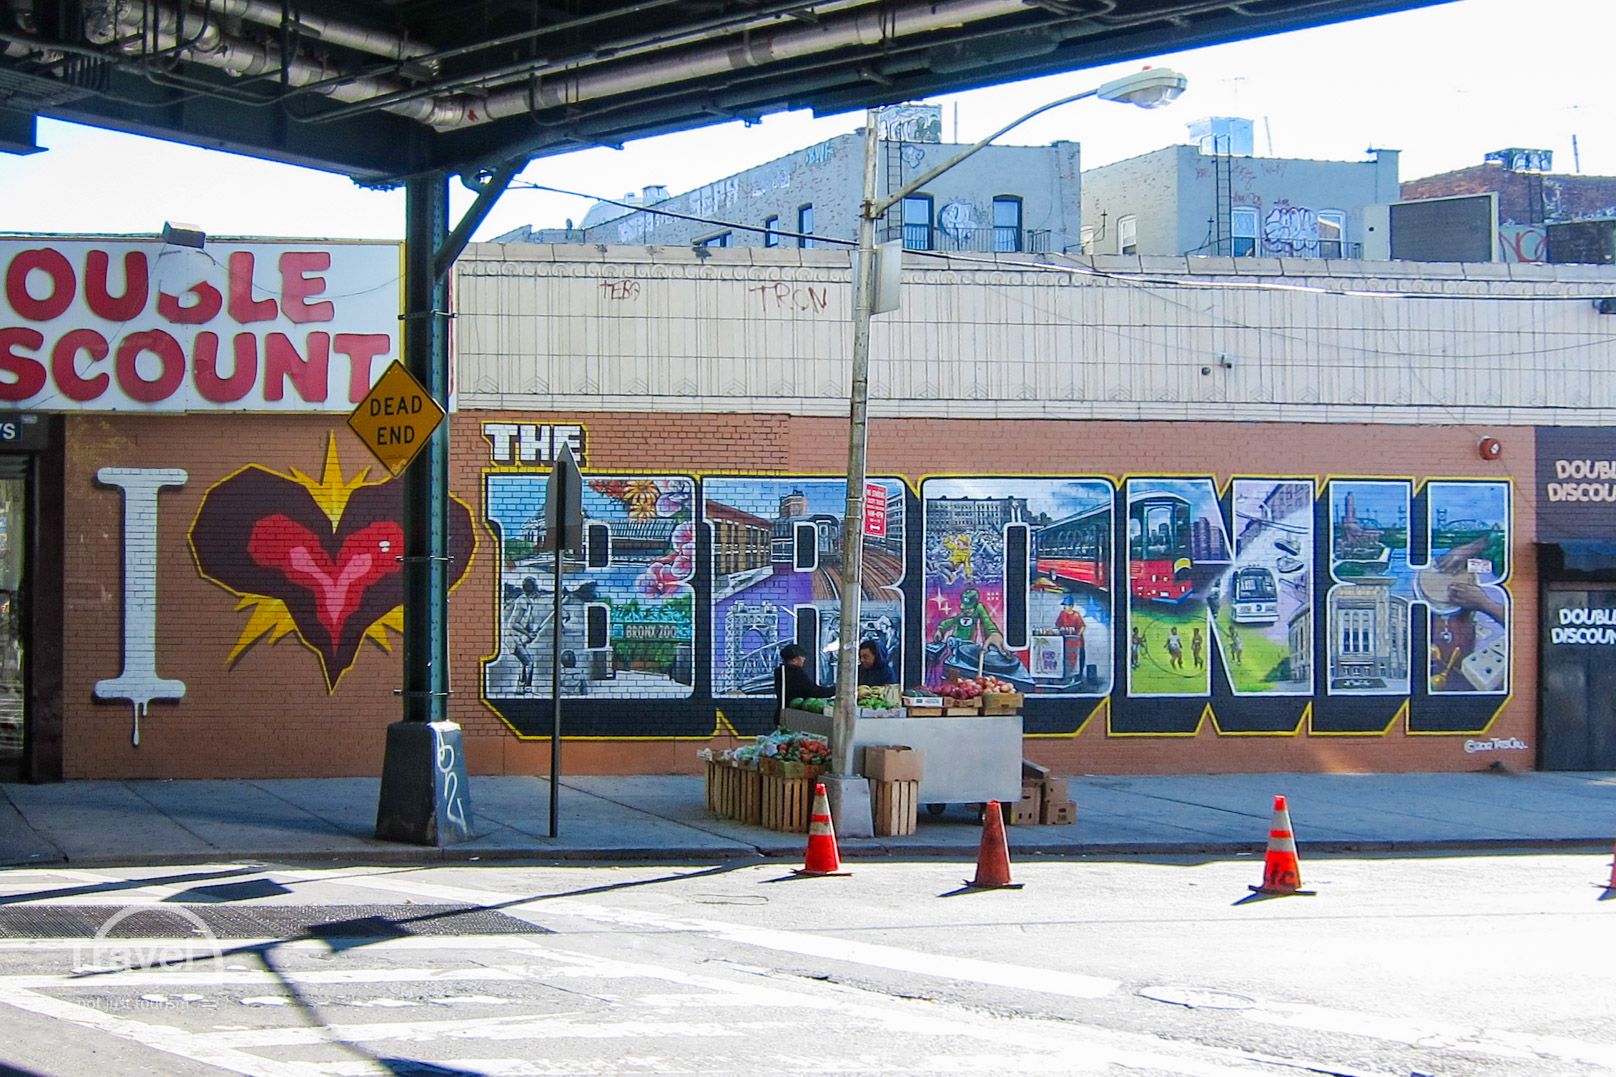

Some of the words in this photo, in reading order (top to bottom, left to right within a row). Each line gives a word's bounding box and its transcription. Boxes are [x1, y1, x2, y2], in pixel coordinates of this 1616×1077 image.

[0, 326, 391, 404] SCOUNT
[369, 395, 423, 417] DEAD
[377, 425, 415, 446] END
[484, 424, 581, 461] THE
[94, 466, 189, 700] I
[482, 472, 1512, 704] BRONX
[625, 624, 656, 639] BRONX
[658, 624, 677, 639] ZOO
